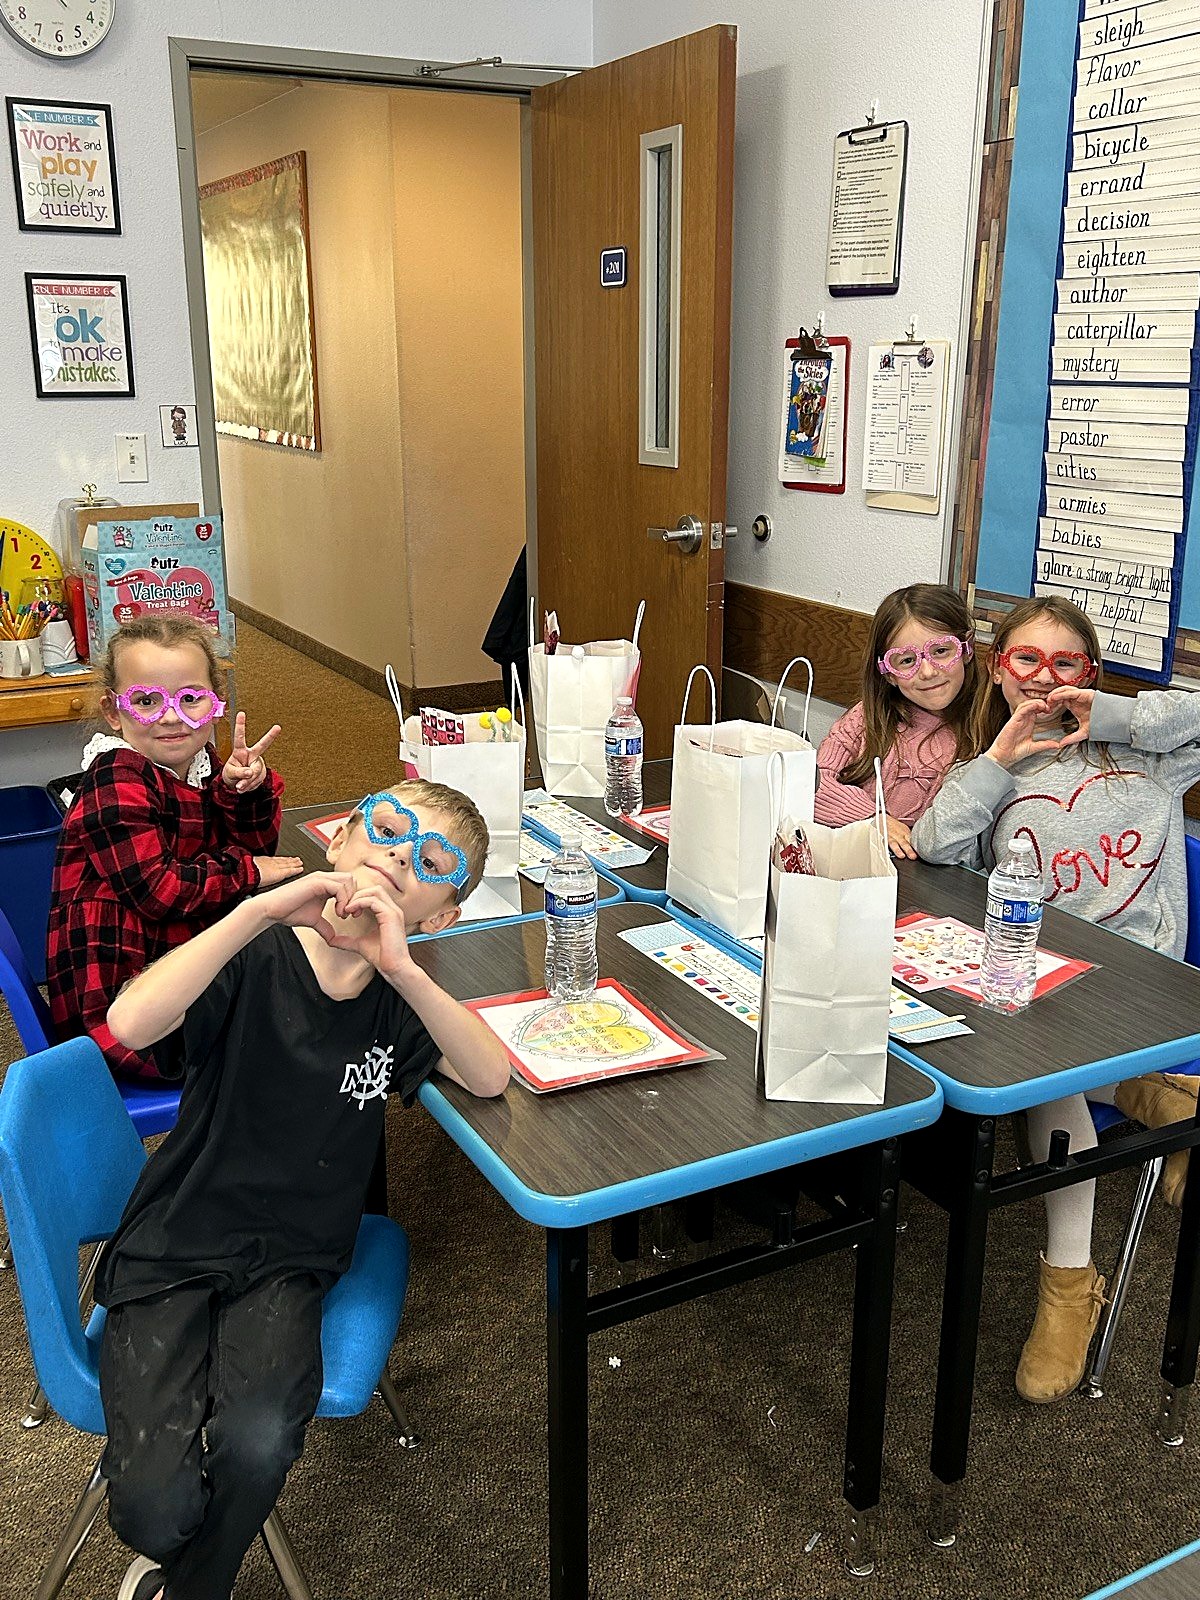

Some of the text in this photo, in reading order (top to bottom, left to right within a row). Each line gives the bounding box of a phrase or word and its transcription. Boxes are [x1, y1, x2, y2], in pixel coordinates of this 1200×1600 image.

[18, 6, 26, 19] 8
[86, 11, 95, 24] 4
[34, 23, 42, 36] 7
[55, 30, 63, 43] 6
[74, 25, 82, 38] 5
[1094, 7, 1144, 47] sleigh
[1086, 54, 1141, 86] flavor
[1089, 88, 1147, 119] collar
[44, 114, 84, 124] NUMBER
[20, 129, 102, 152] Work and
[1084, 125, 1149, 164] bicycle
[41, 153, 97, 182] play
[1081, 162, 1145, 197] errand
[28, 179, 105, 202] safely and
[39, 201, 108, 222] quietly.
[1078, 206, 1149, 232] decision
[1078, 241, 1146, 276] eighteen
[62, 286, 100, 295] NUMBER
[103, 287, 110, 295] 6
[1070, 277, 1128, 303] author
[51, 302, 70, 314] It's
[56, 308, 105, 343] ok
[1067, 313, 1157, 346] caterpillar
[62, 344, 122, 361] make
[1062, 348, 1120, 380] mystery
[804, 367, 823, 379] Skies
[1062, 397, 1099, 412] error
[1059, 422, 1108, 452] pastor
[1057, 455, 1097, 480] cities
[1059, 496, 1107, 515] armies
[11, 538, 18, 552] 1
[1052, 520, 1102, 549] babies
[31, 555, 42, 569] 2
[1077, 567, 1083, 579] a
[1086, 559, 1112, 590] strong
[1115, 562, 1145, 594] bright
[1149, 566, 1171, 598] light
[130, 582, 202, 600] Valentine
[1100, 595, 1145, 628] helpful
[1107, 629, 1137, 657] heal
